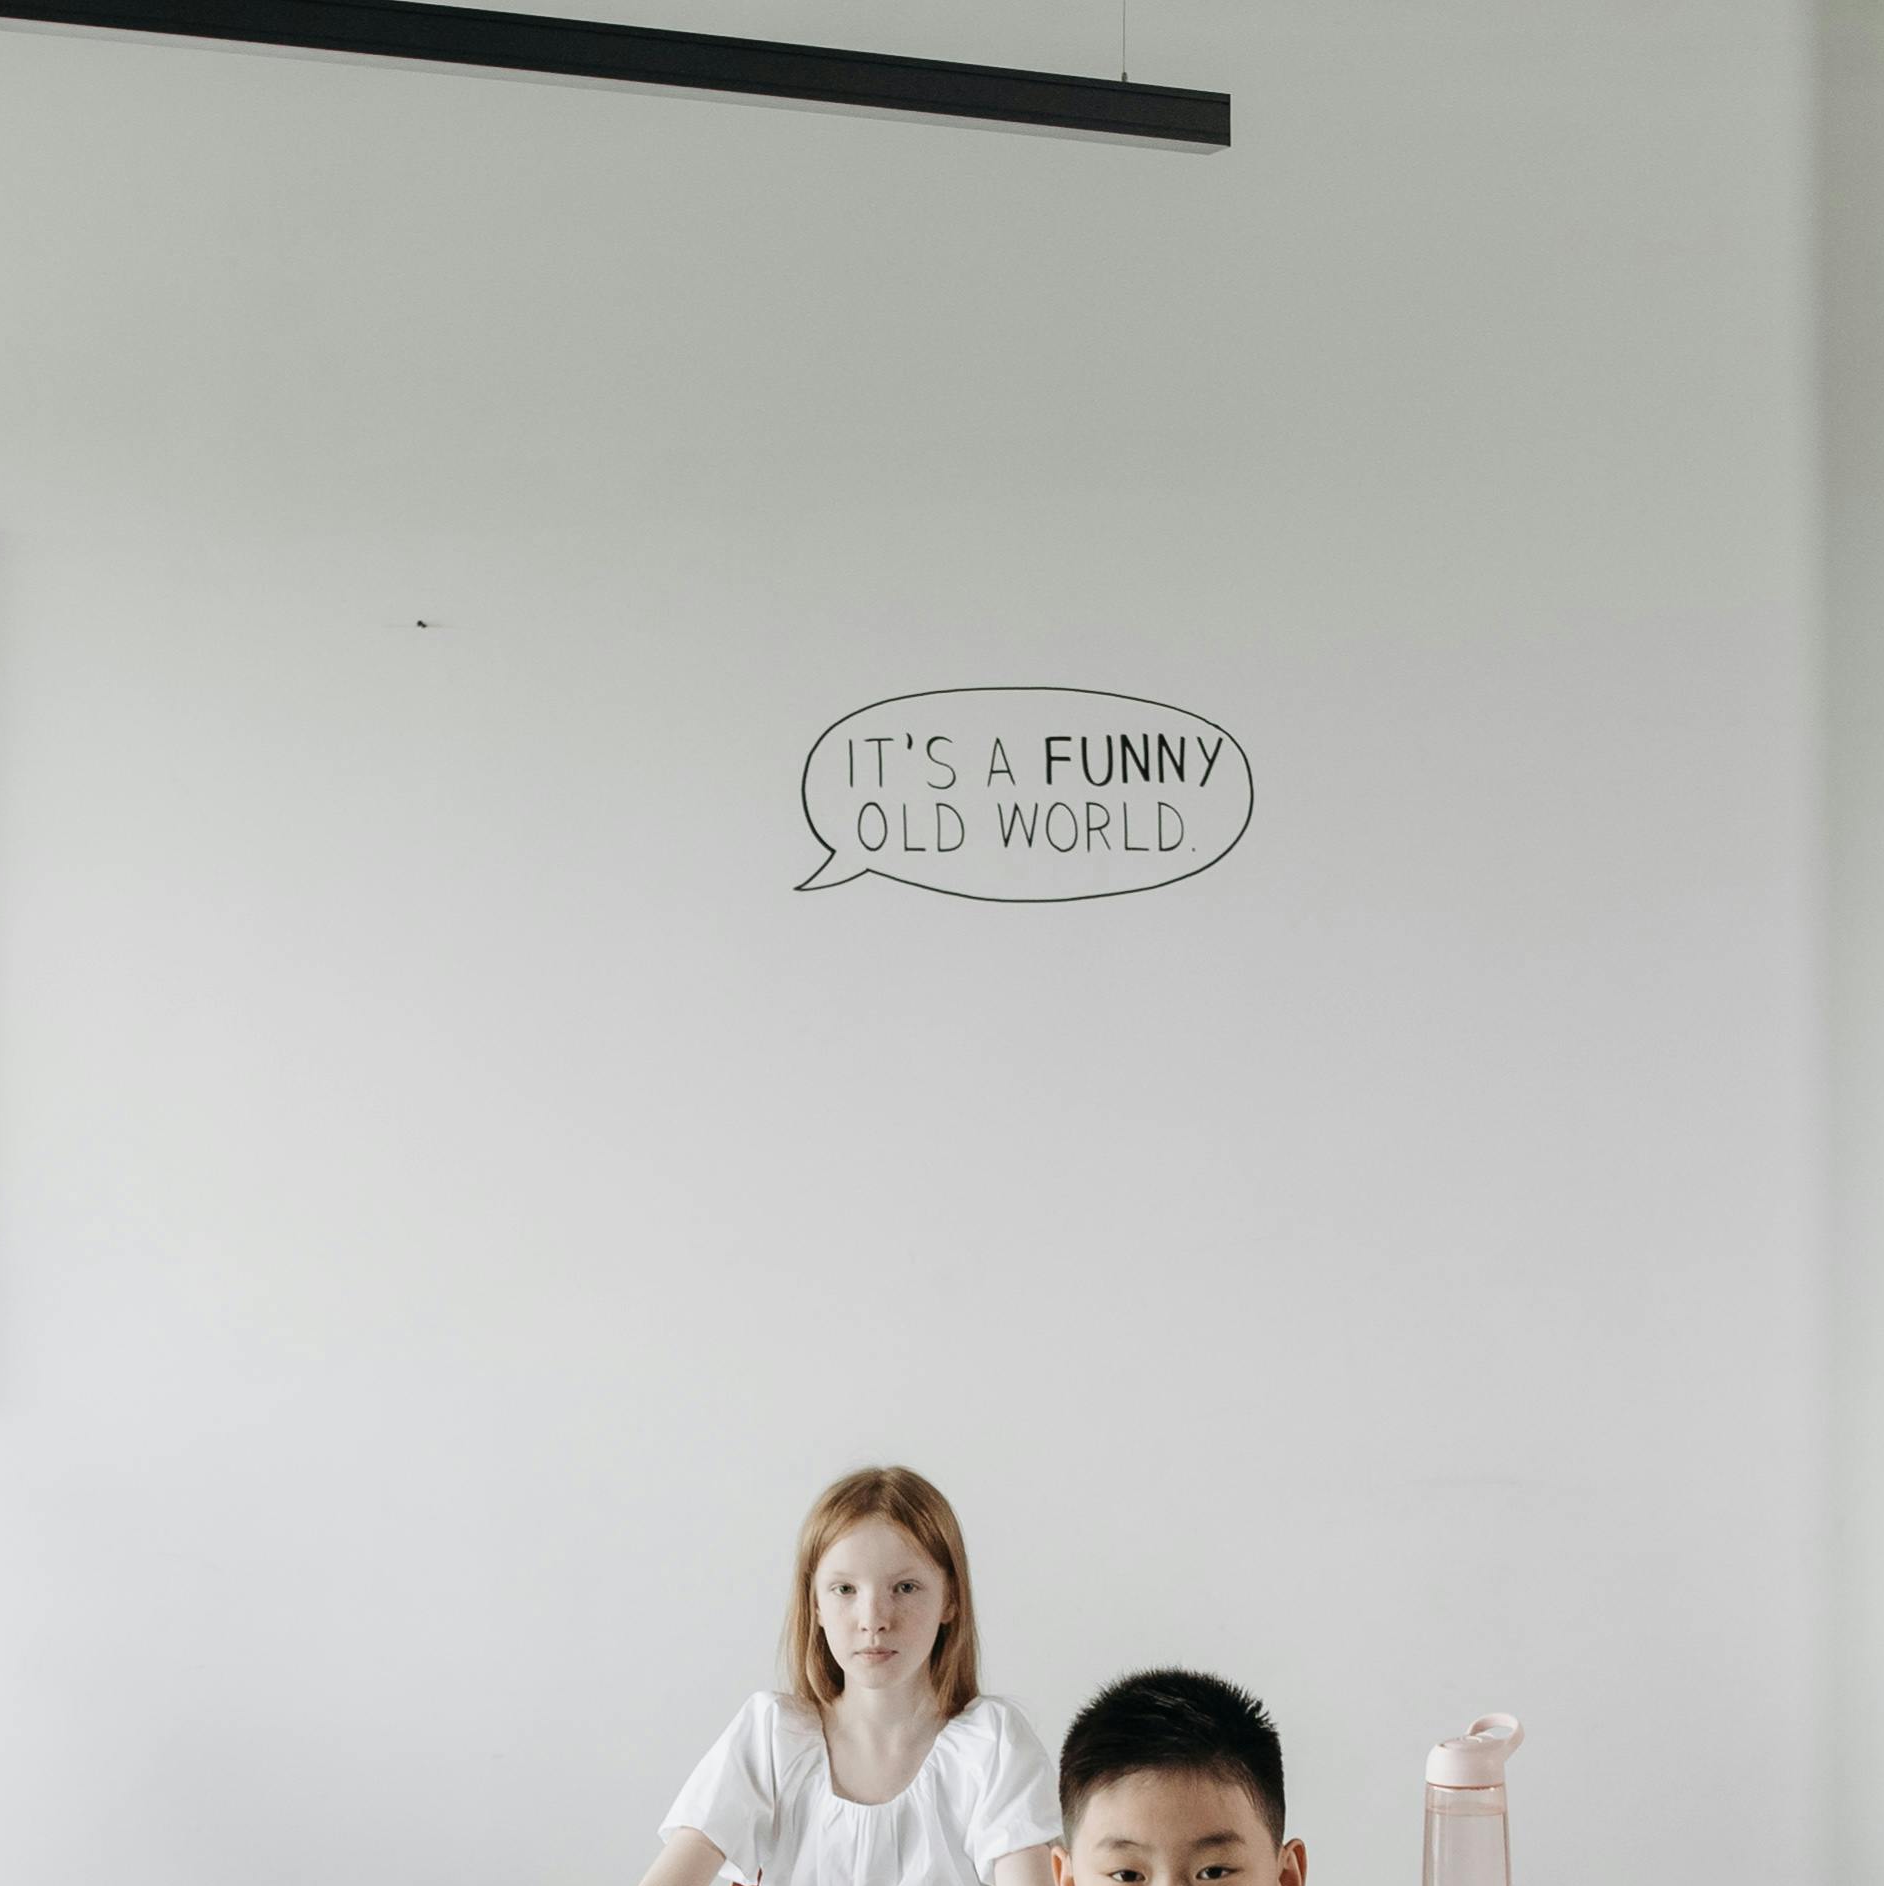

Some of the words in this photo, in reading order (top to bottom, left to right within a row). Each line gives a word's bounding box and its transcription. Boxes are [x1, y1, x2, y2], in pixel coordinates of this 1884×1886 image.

[848, 733, 956, 789] IT'S
[986, 736, 1016, 787] A
[1044, 733, 1224, 787] FUNNY
[857, 801, 966, 852] OLD
[997, 801, 1197, 853] WORLD.
